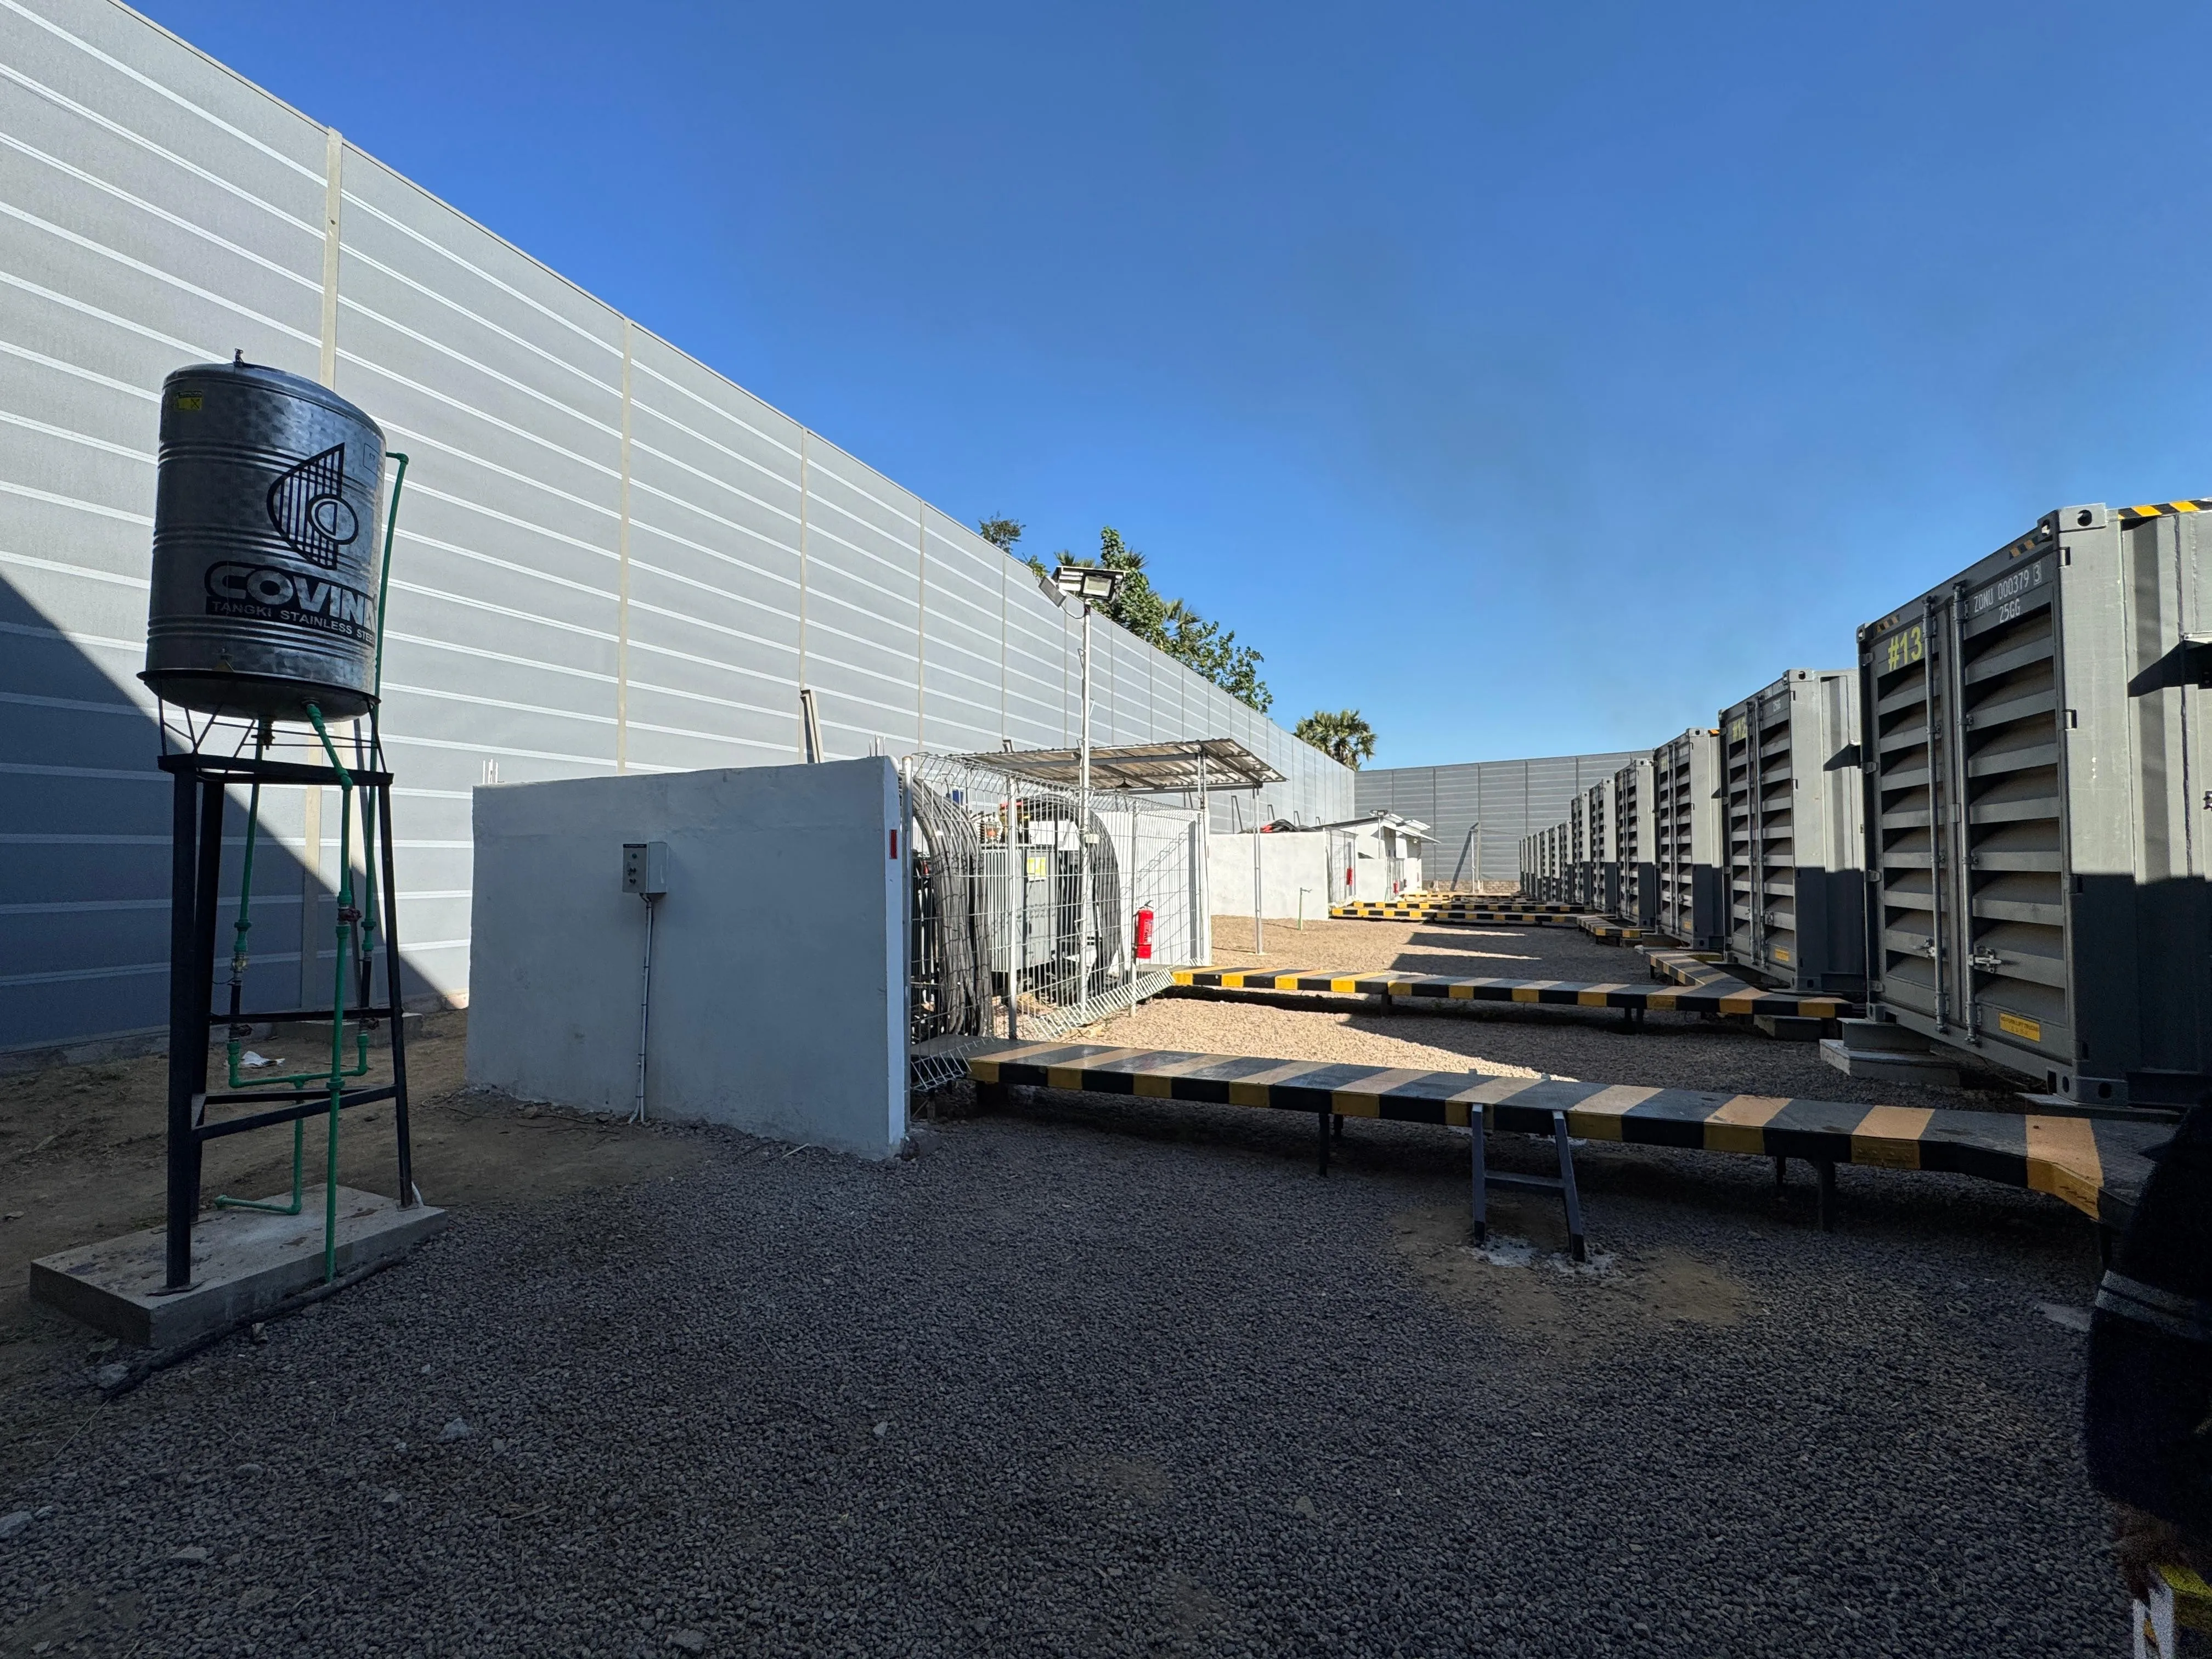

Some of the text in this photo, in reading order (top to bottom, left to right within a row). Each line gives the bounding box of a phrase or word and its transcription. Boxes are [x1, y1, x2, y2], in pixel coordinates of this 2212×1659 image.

[1997, 569, 2029, 600] 000379
[2033, 563, 2041, 583] 3
[211, 601, 271, 617] TANGKI
[280, 610, 353, 635] STAINLESS
[1999, 598, 2021, 624] 25GG
[1888, 627, 1922, 672] #13
